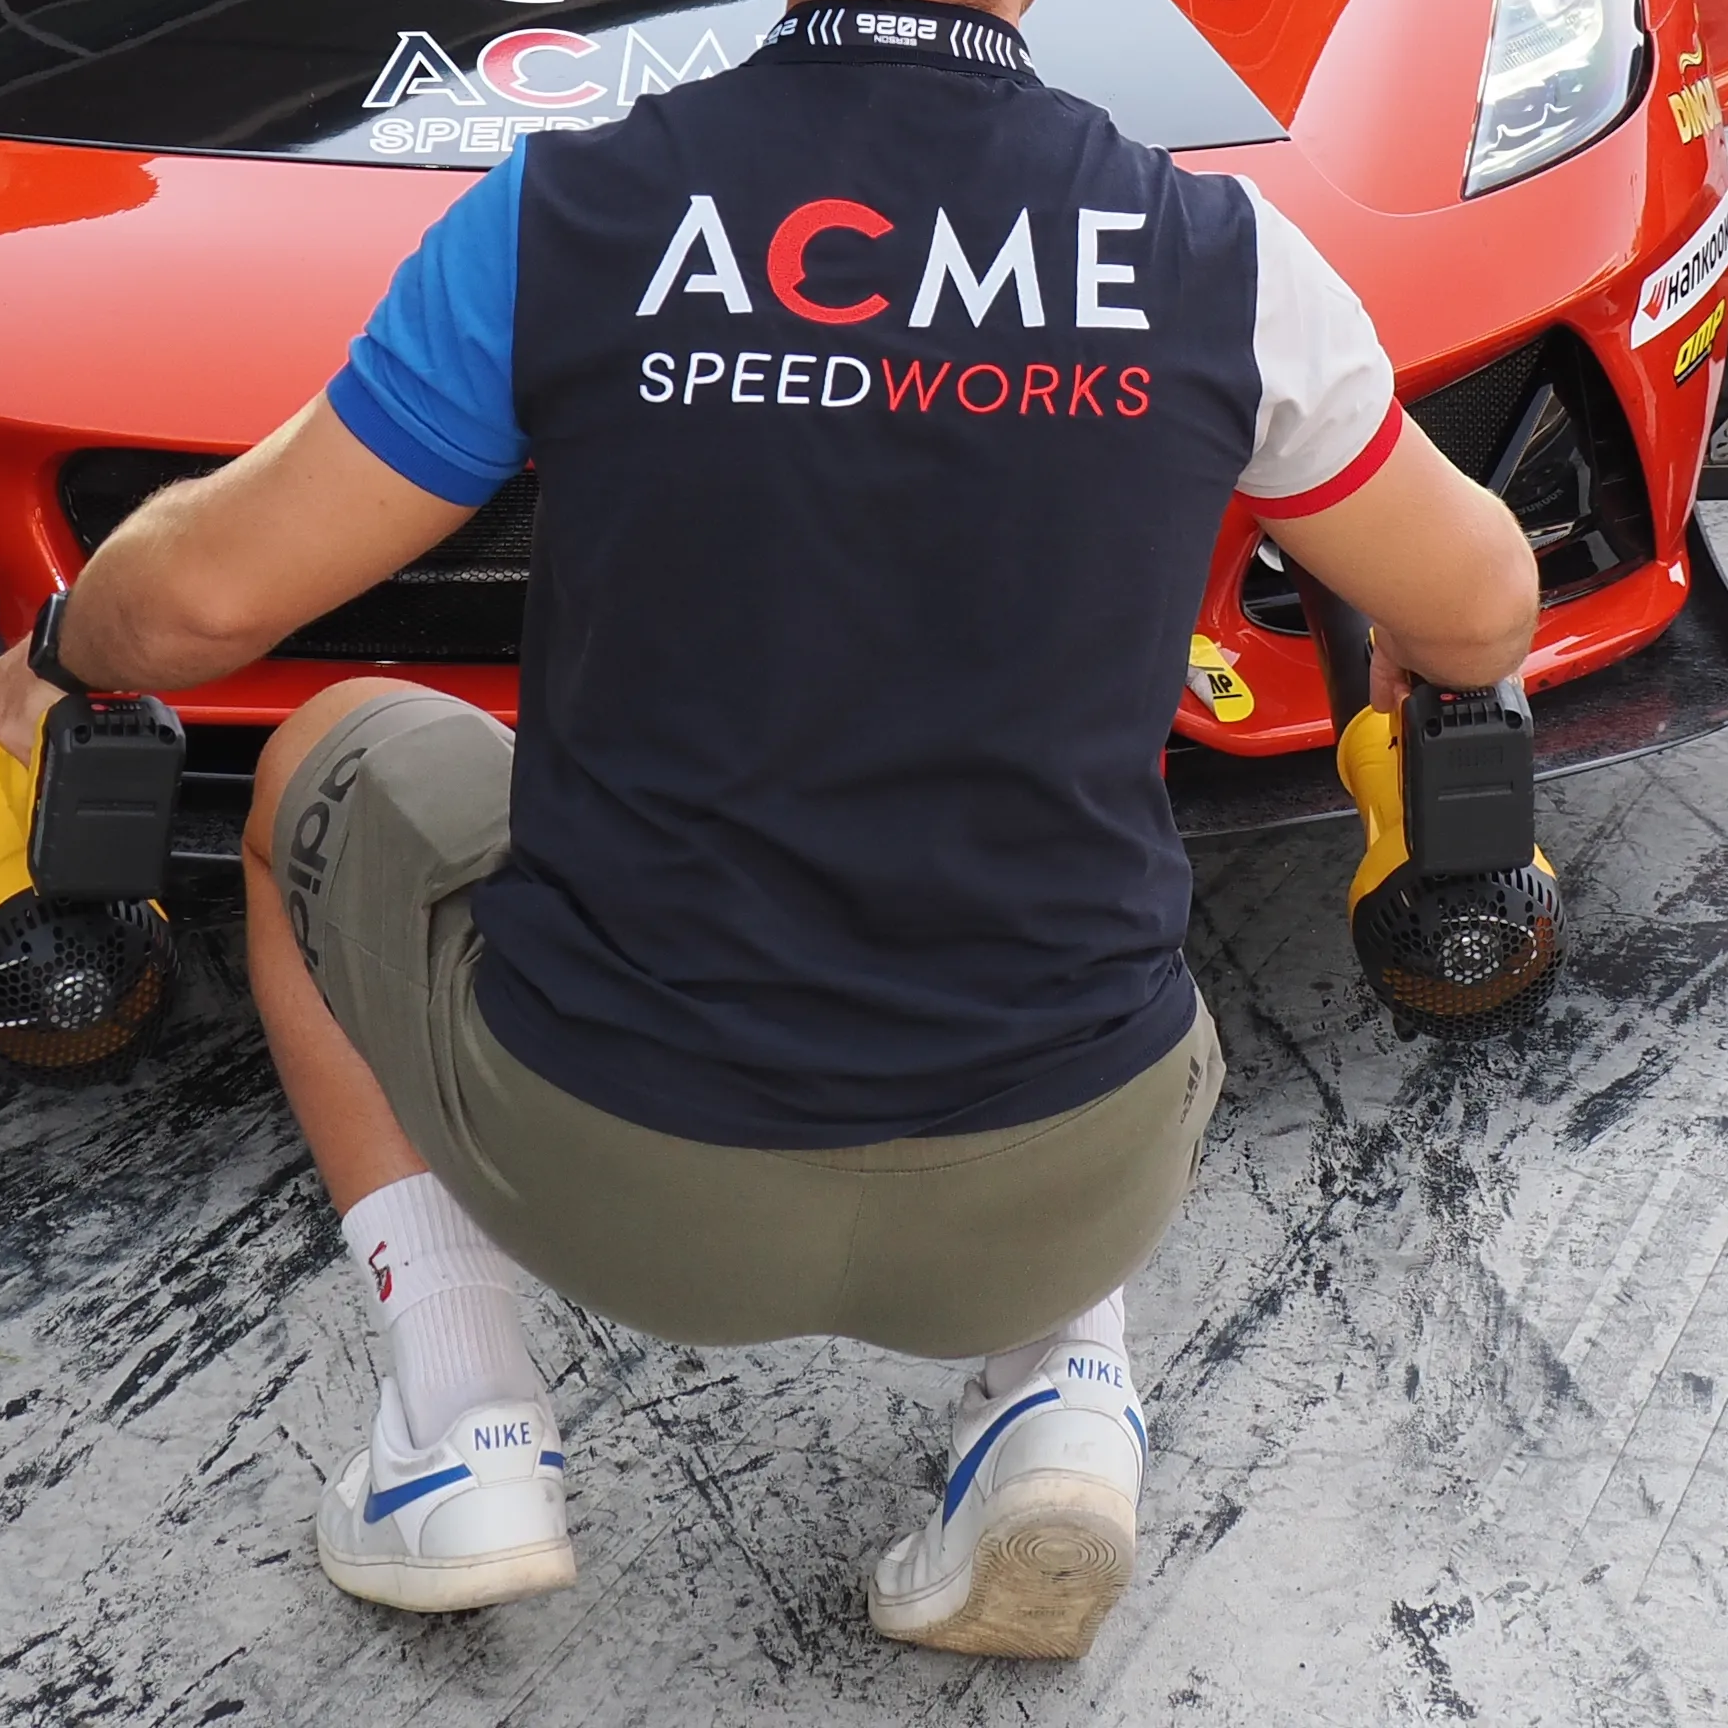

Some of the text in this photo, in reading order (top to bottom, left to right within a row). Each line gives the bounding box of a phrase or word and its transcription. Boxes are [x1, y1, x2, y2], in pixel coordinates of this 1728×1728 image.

[856, 13, 938, 40] 2026
[362, 27, 769, 109] ACM
[636, 195, 1151, 330] ACME
[639, 351, 1152, 418] SPEEDWORKS
[1065, 1356, 1125, 1390] NIKE
[474, 1421, 531, 1450] NIKE
